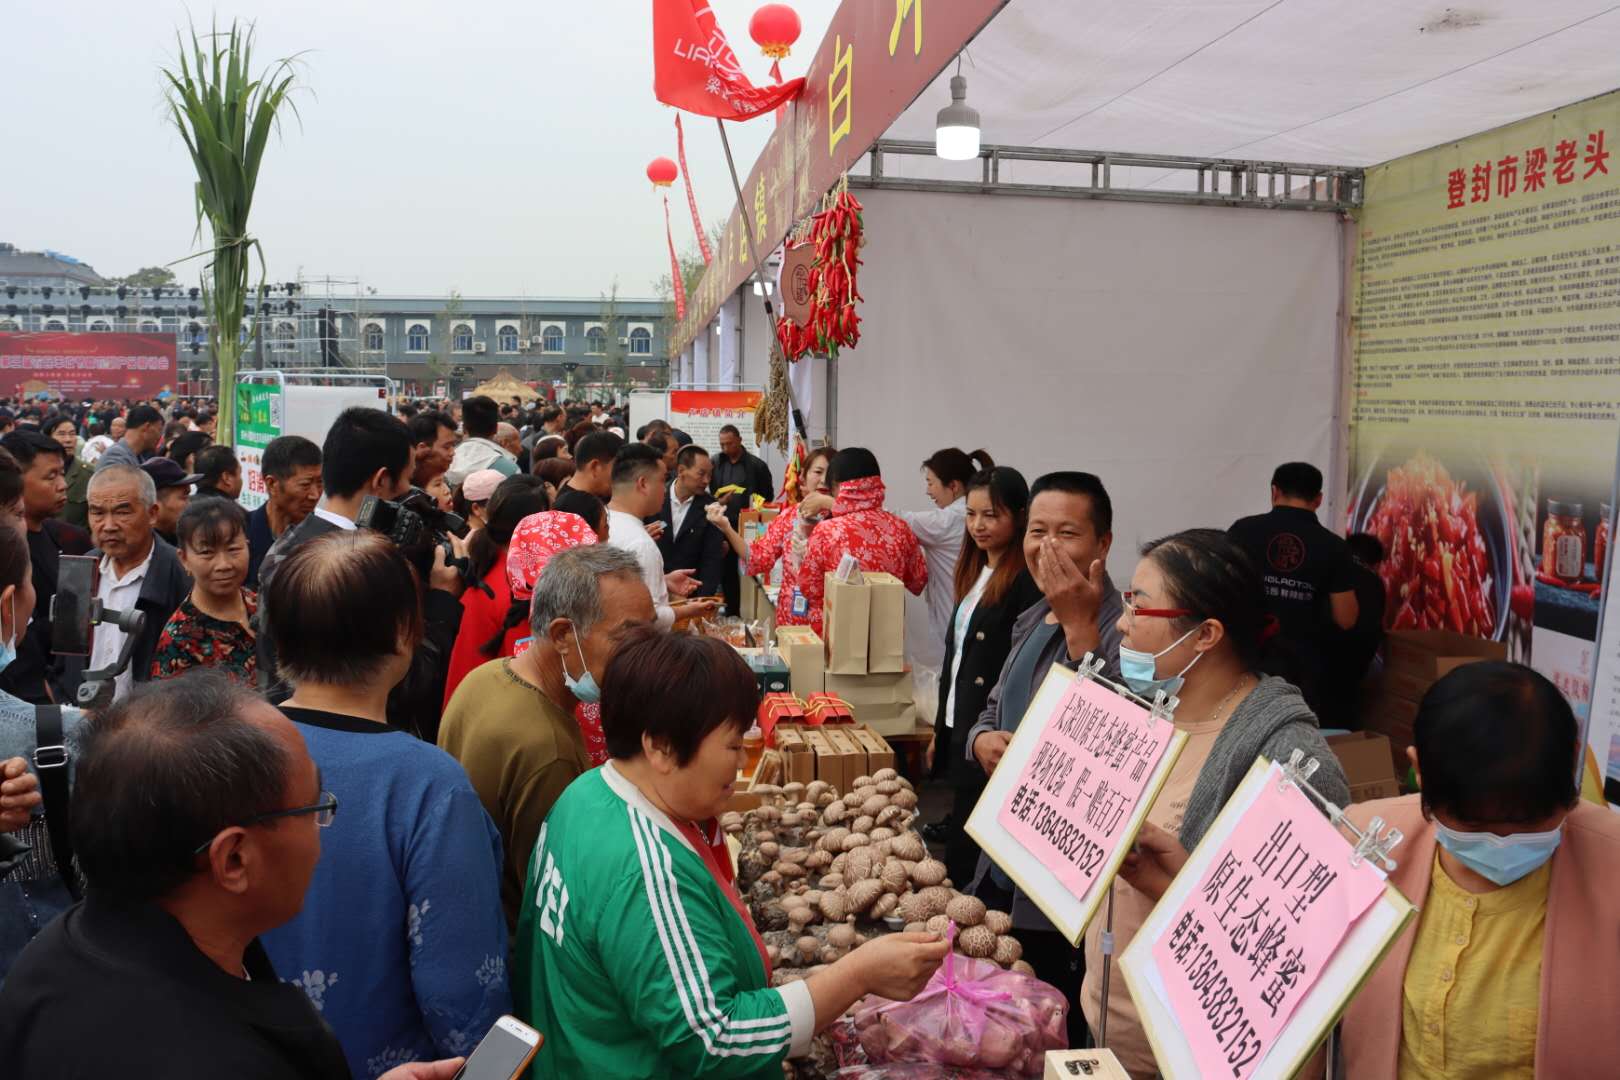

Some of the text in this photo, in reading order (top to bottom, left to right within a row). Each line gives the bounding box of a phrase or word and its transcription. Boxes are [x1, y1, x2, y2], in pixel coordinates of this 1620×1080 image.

[1447, 130, 1609, 209] 登封市梁老头
[1053, 693, 1159, 782] 大深山原生态蜂蜜产品
[1010, 782, 1105, 878] 电话:13643832152
[1028, 741, 1131, 838] 现场化验 假一赔百万
[1252, 820, 1338, 924] 出口型
[1203, 849, 1306, 1018] 原生态蜂蜜
[1168, 909, 1262, 1078] 电话:13643832152
